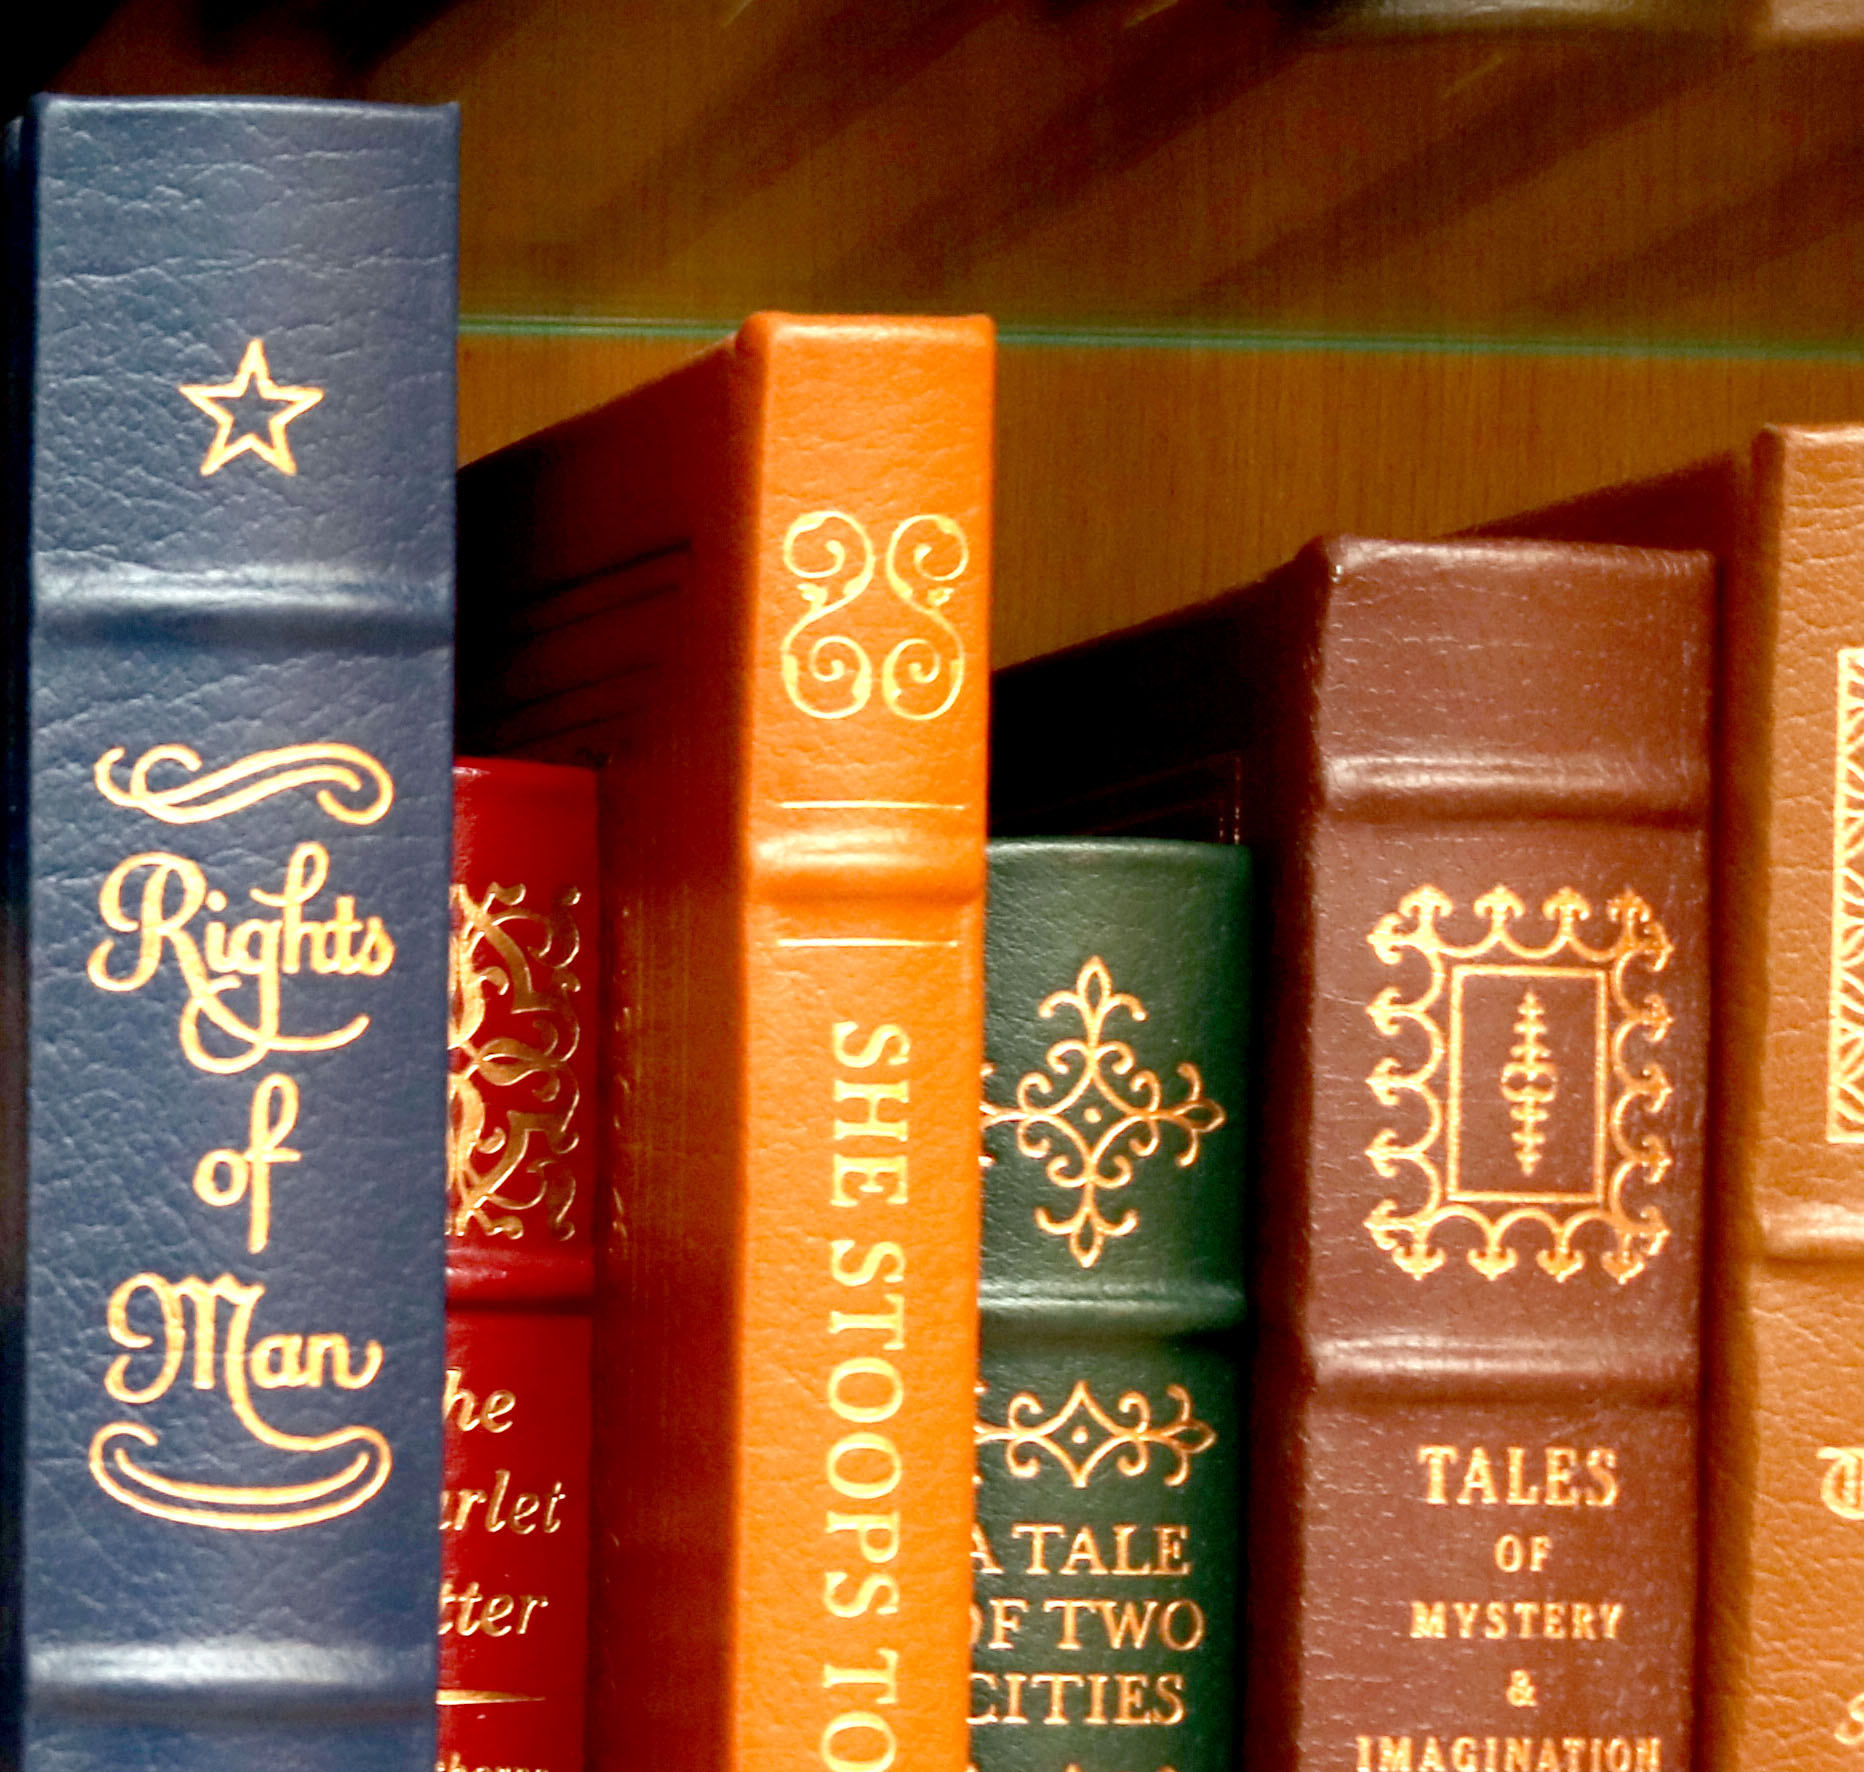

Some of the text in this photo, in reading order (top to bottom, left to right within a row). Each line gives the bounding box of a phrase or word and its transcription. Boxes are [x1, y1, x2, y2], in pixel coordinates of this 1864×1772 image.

[88, 841, 394, 1075] Rights
[830, 1020, 911, 1208] SHE
[193, 1072, 300, 1253] of
[104, 1270, 382, 1451] Man
[442, 1367, 516, 1434] he
[822, 1238, 908, 1618] STOOPS
[439, 1469, 566, 1535] rlet
[1418, 1445, 1618, 1505] TALES
[1012, 1524, 1191, 1576] TALE
[1495, 1535, 1553, 1572] OF
[437, 1581, 549, 1637] tter
[1043, 1598, 1205, 1651] TWO
[1410, 1601, 1623, 1639] MYSTERY
[1506, 1670, 1537, 1707] &
